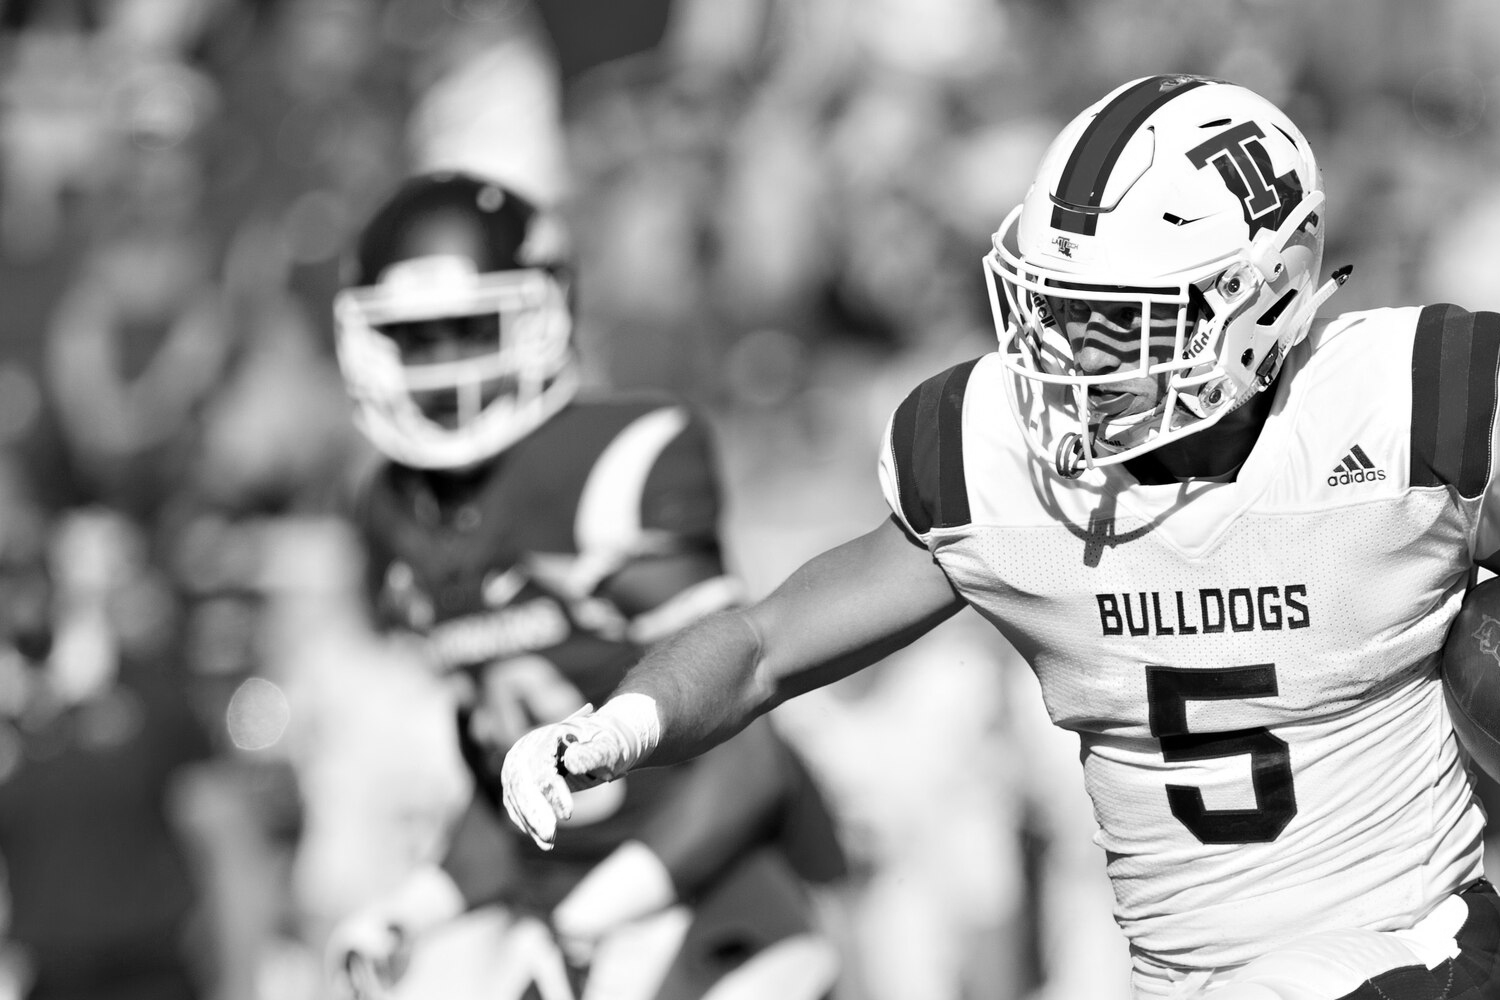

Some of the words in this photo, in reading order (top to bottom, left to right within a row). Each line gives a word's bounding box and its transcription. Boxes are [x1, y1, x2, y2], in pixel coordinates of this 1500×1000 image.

[1327, 469, 1386, 487] adidas
[1096, 584, 1310, 636] BULLDOGS
[1145, 663, 1298, 845] 5
